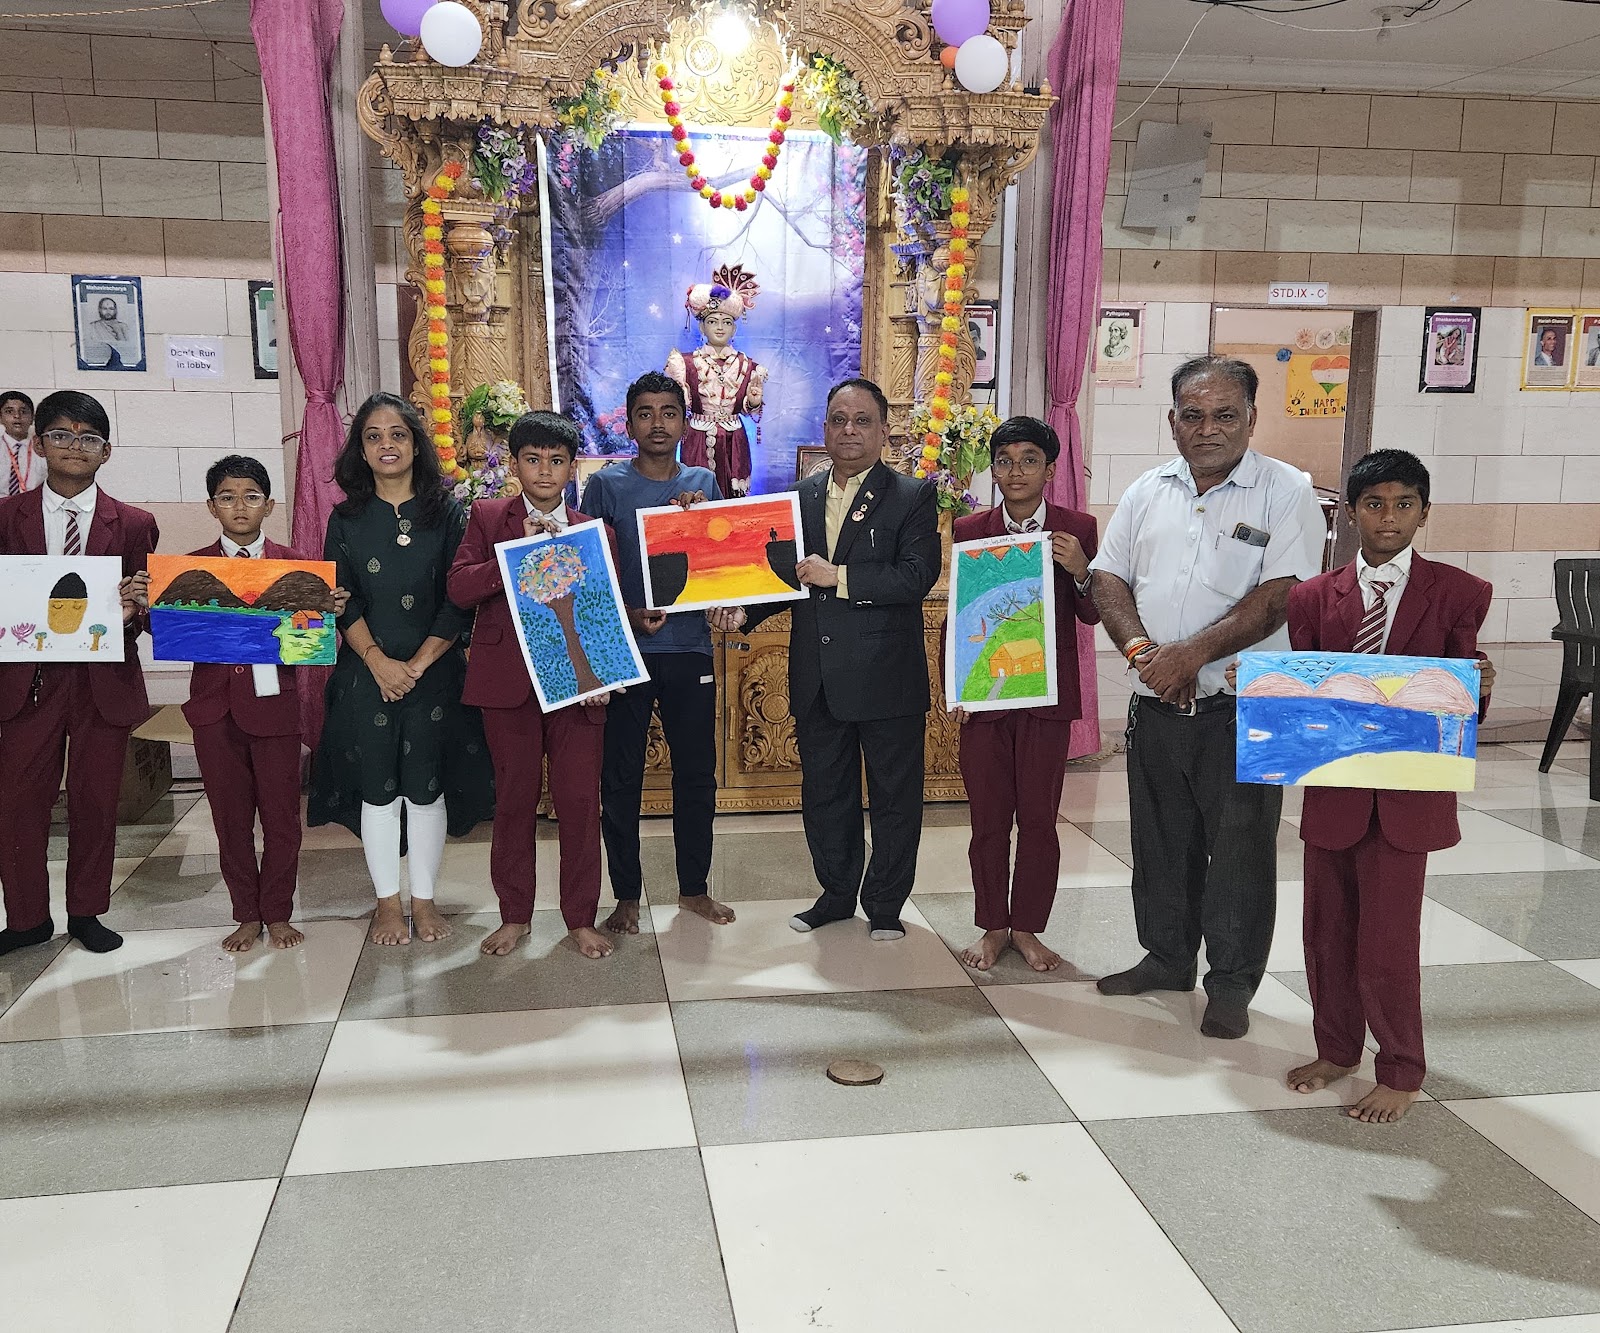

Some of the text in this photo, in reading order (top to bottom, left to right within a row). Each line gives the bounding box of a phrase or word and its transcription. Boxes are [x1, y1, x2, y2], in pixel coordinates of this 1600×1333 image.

[1317, 288, 1325, 298] C
[170, 348, 216, 357] Don't Run
[176, 360, 211, 370] in lobby
[1313, 398, 1341, 408] HAPPY
